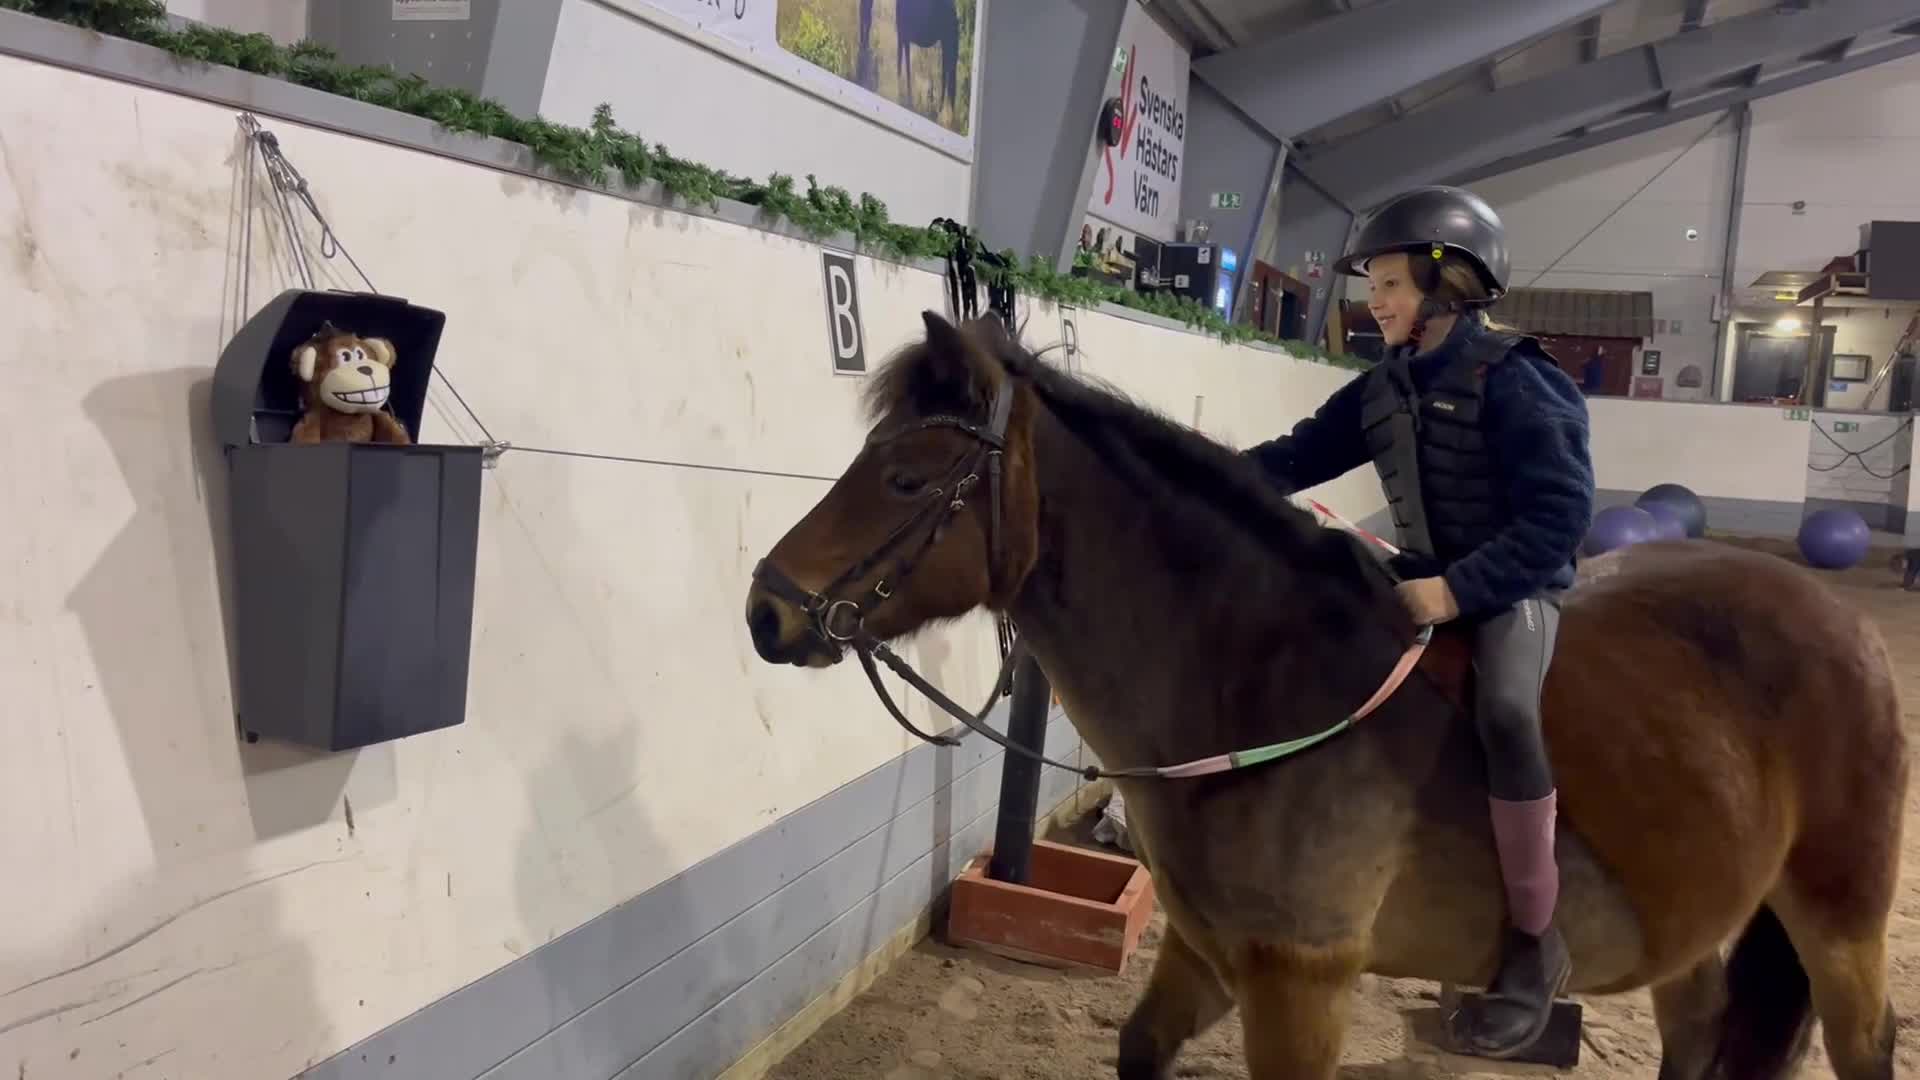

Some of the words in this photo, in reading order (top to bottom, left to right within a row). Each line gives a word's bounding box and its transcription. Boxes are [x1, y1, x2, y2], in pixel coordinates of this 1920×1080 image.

[1139, 76, 1184, 139] Svenska
[1136, 127, 1178, 182] Hästars
[1134, 172, 1159, 217] Värn
[830, 265, 858, 359] B
